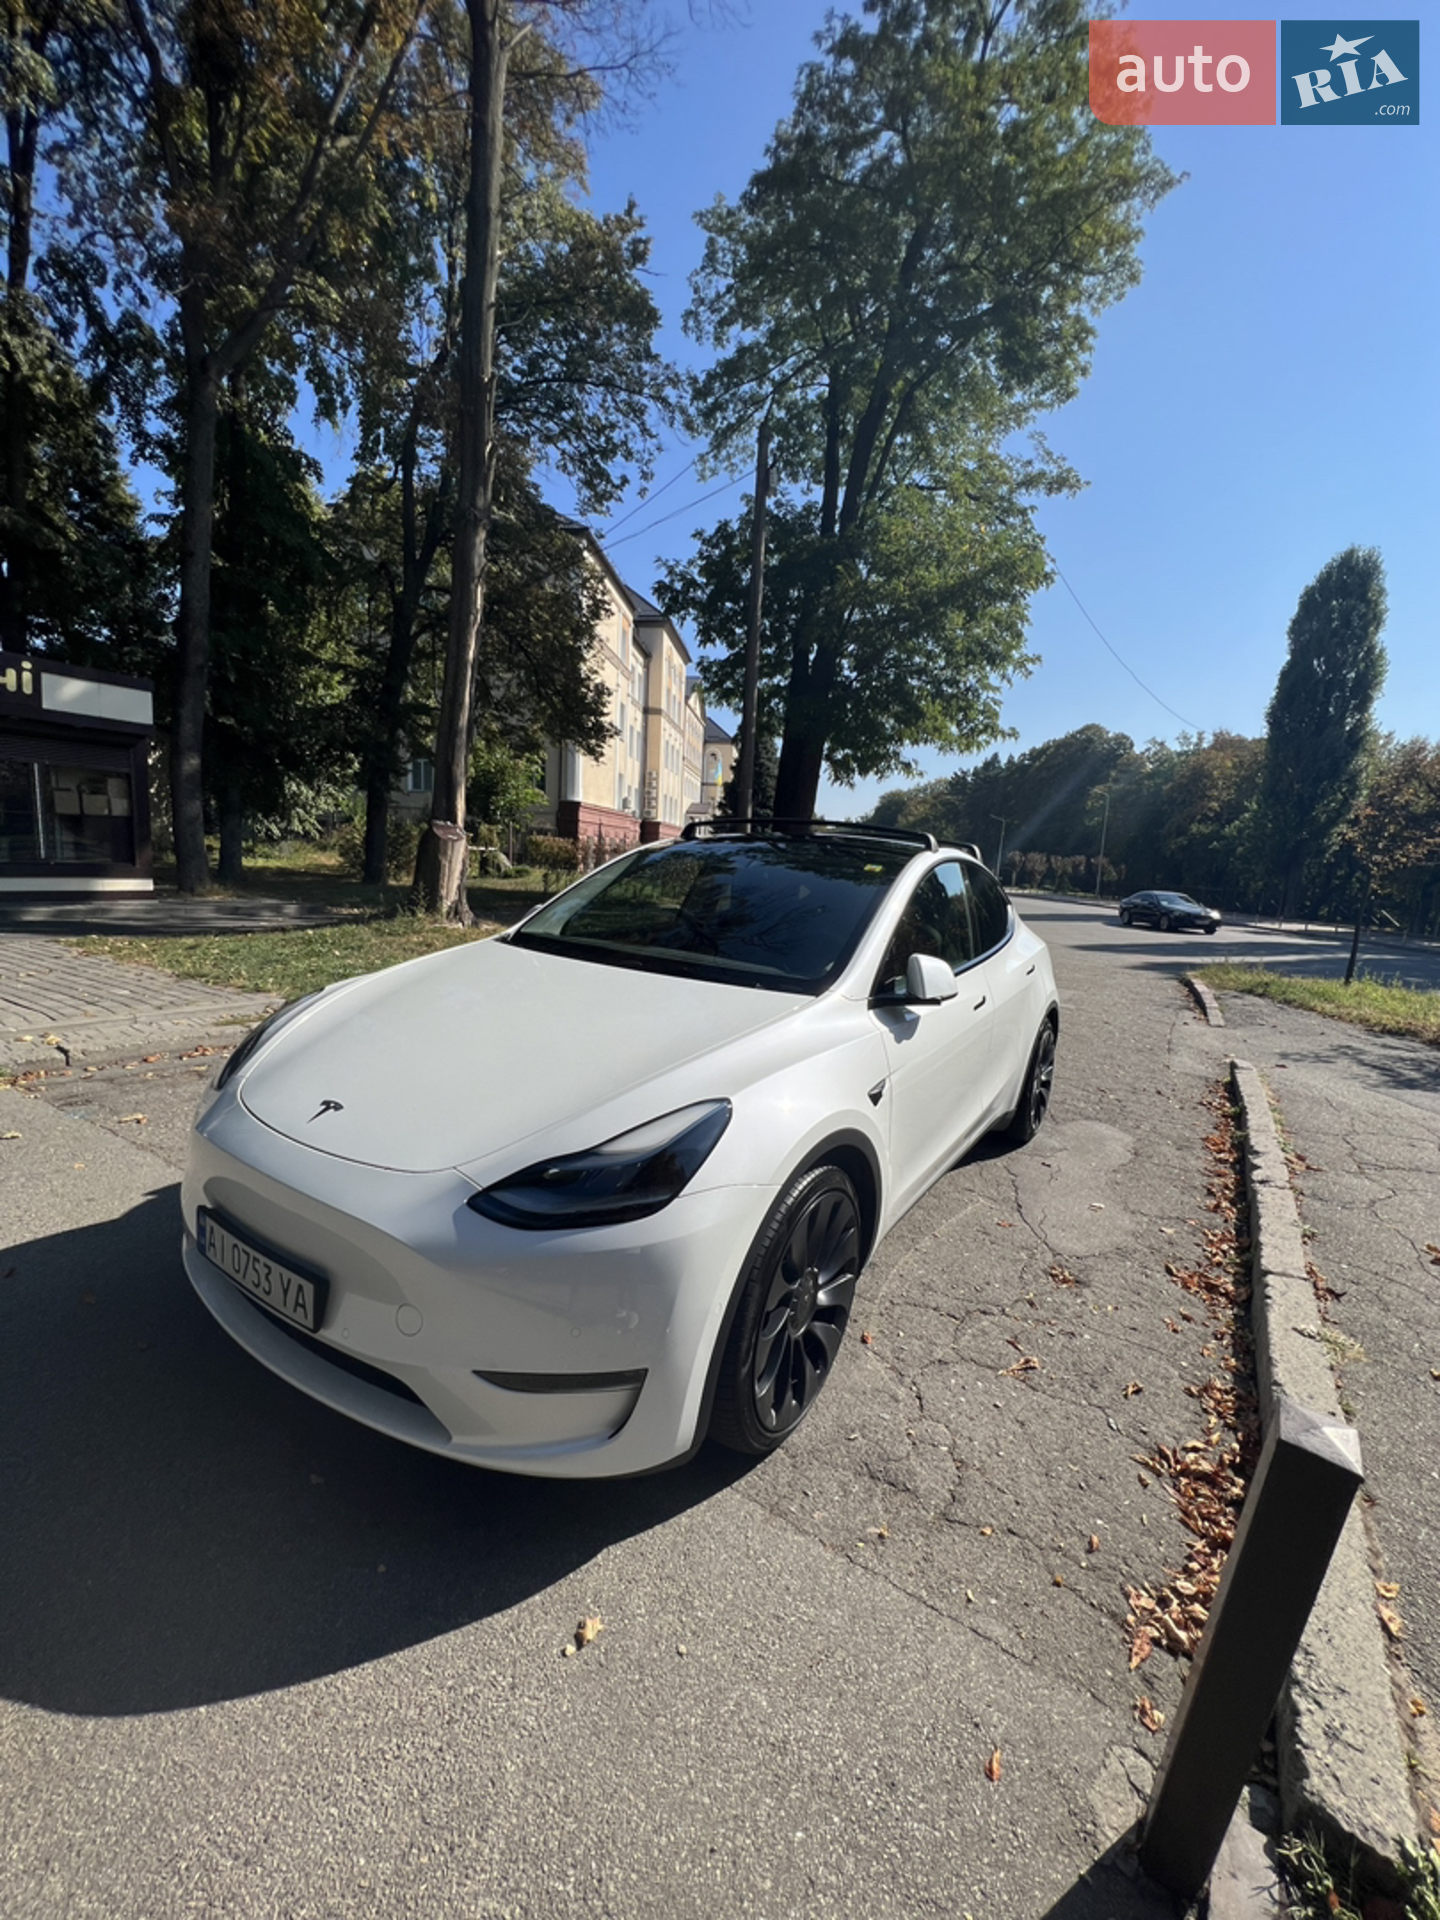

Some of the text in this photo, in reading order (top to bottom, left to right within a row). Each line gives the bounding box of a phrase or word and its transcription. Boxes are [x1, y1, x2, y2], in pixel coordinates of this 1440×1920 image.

[207, 1225, 309, 1321] AI 0753 YA
